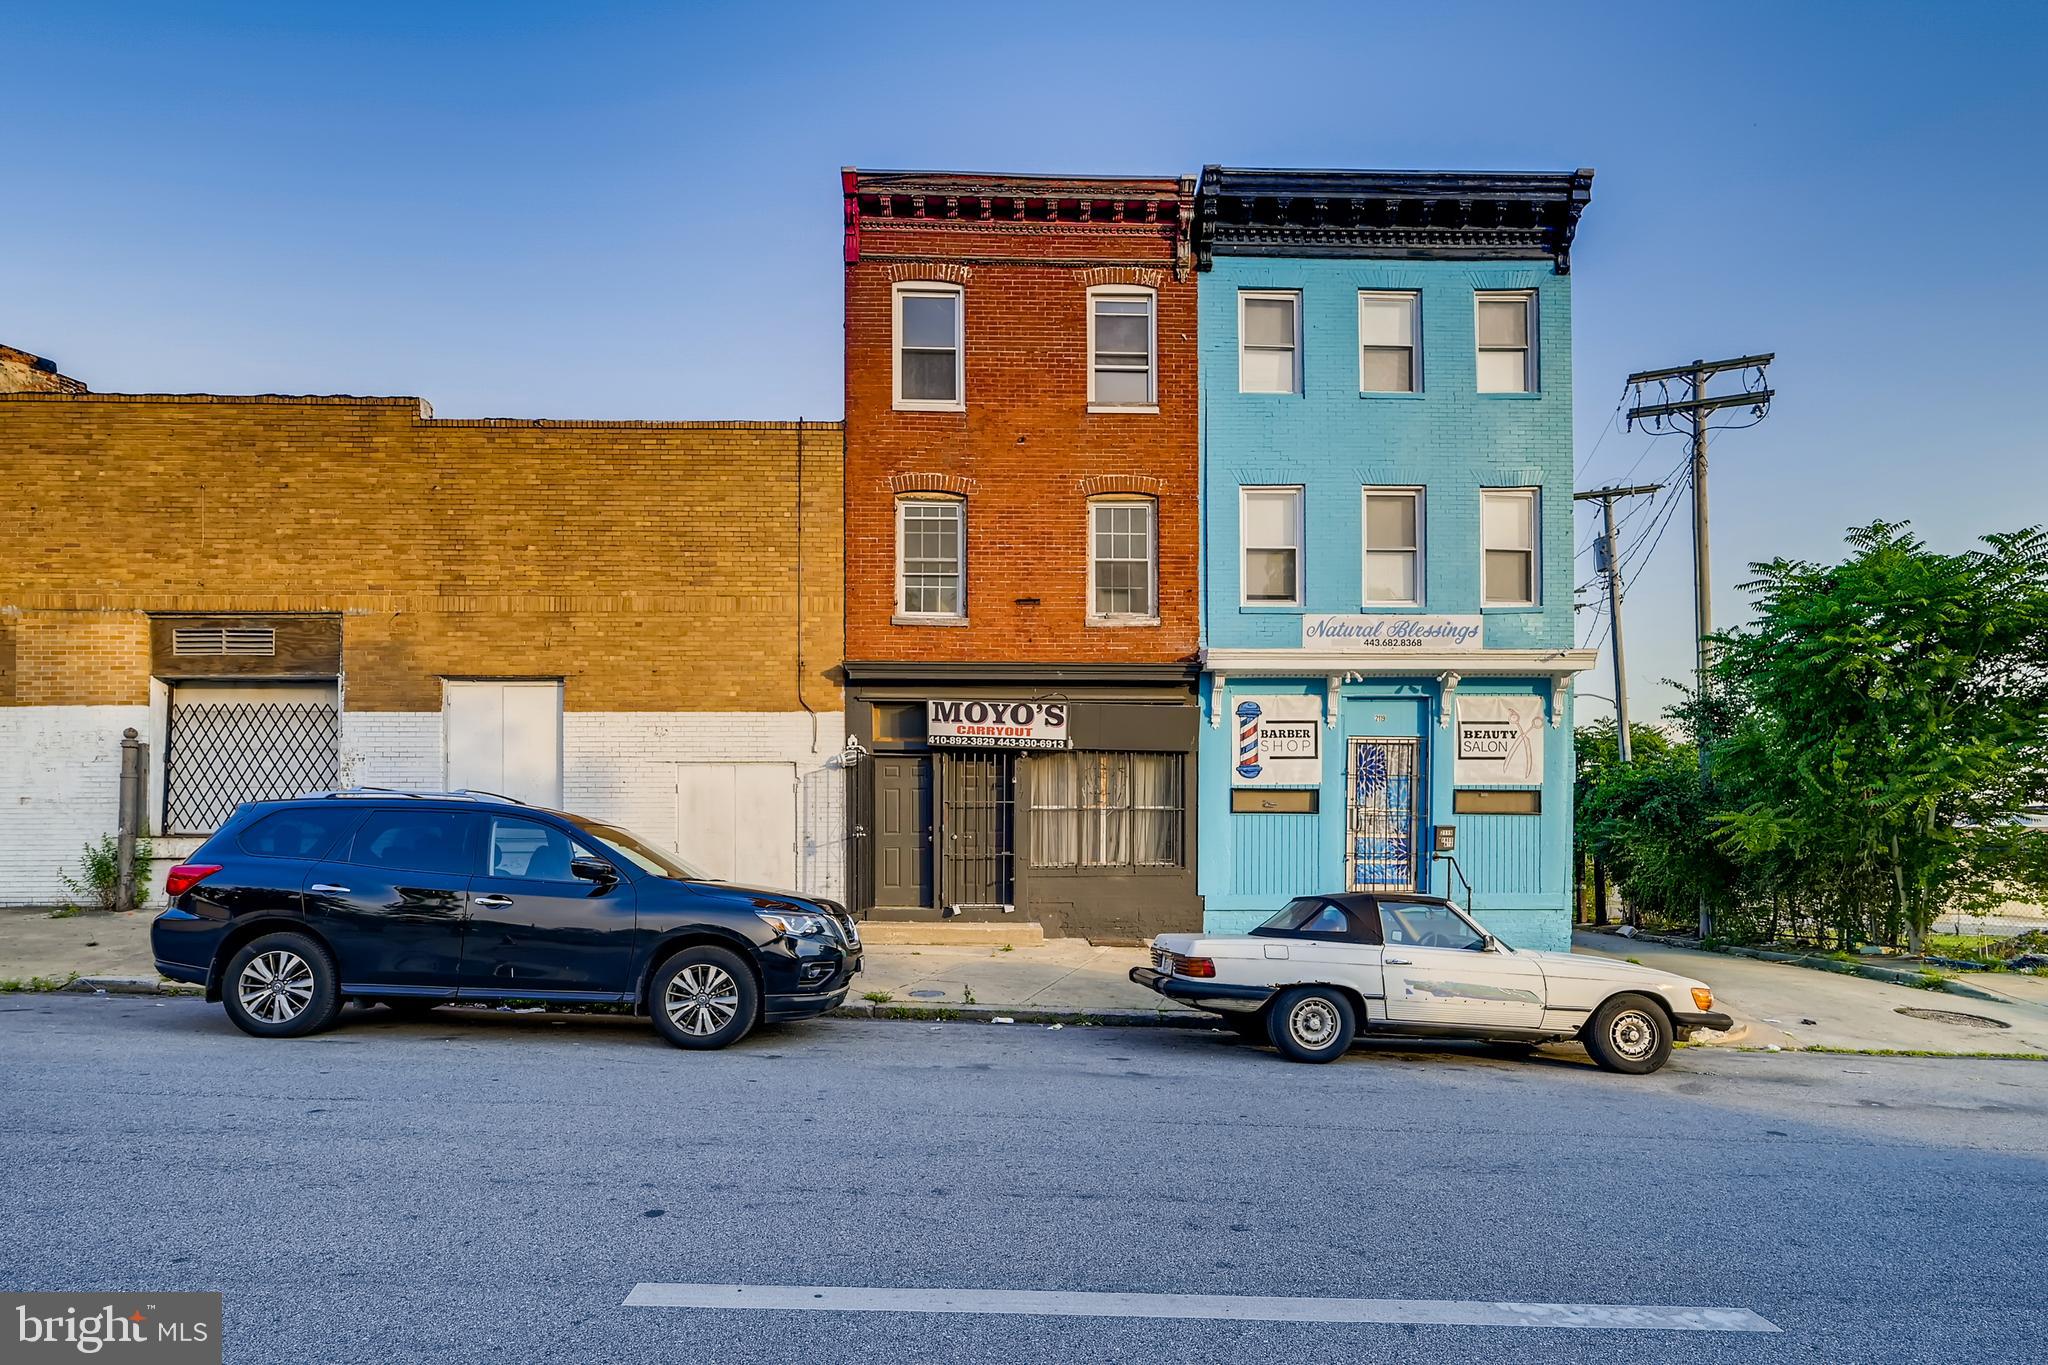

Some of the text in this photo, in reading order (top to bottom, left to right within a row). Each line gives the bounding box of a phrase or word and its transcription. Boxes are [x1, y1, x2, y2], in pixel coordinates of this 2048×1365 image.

[1307, 616, 1480, 644] Natural Blessings
[1363, 638, 1422, 647] 443.682.8368
[932, 701, 1065, 728] MOYO'S
[956, 725, 1033, 737] CARRYOUT
[1260, 729, 1311, 738] BARBER
[1463, 730, 1517, 739] BEAUTY
[928, 735, 1064, 748] 410-892-3829 443-930-6913
[1260, 740, 1311, 752] SHOP
[1463, 740, 1508, 752] SALON
